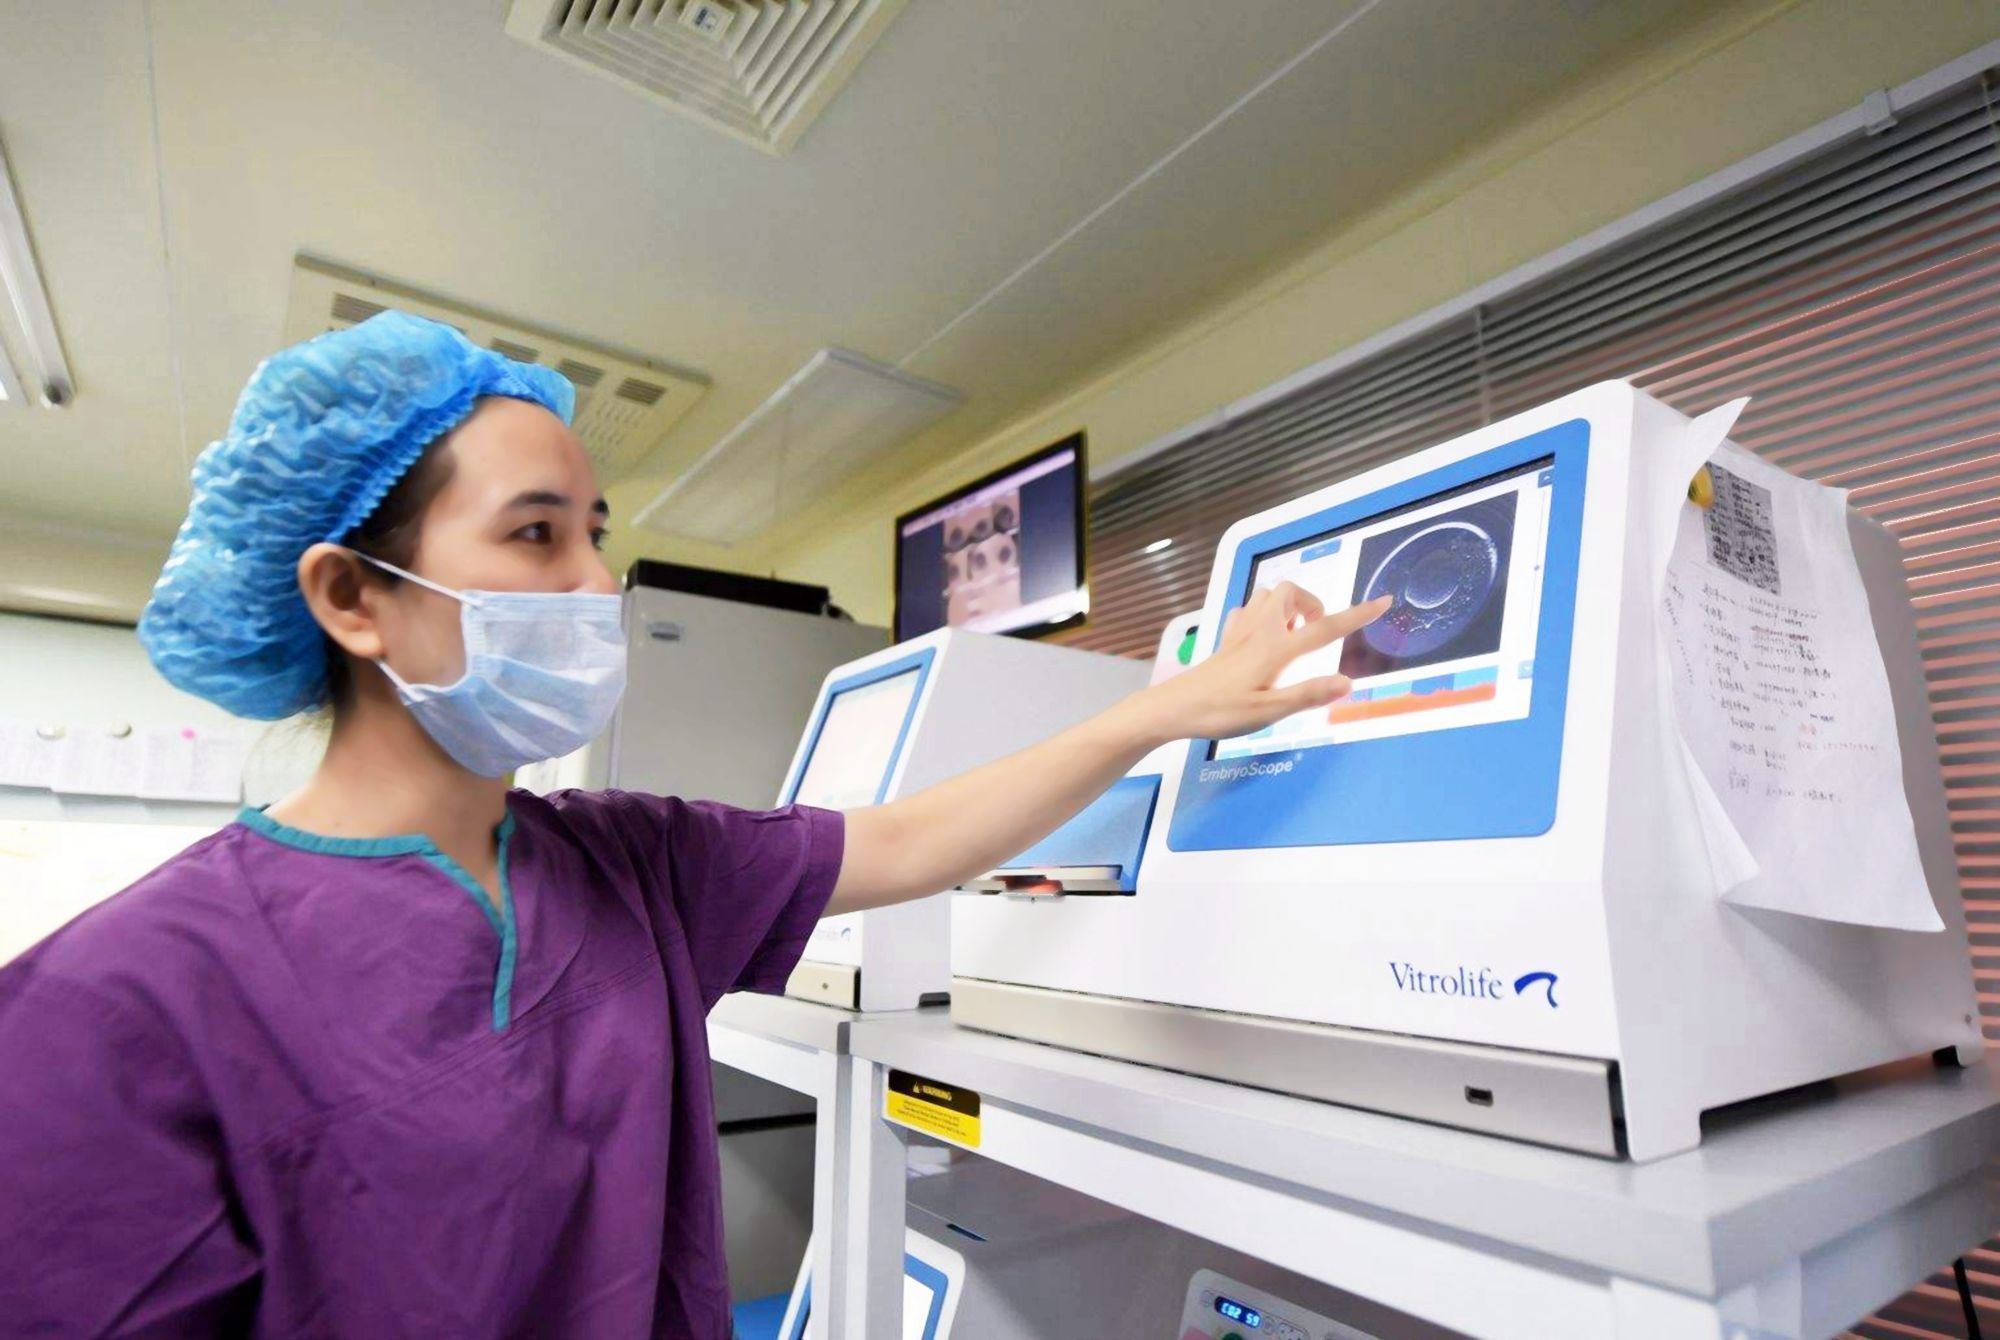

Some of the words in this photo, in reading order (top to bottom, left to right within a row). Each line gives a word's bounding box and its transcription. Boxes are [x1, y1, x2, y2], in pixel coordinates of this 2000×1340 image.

[1199, 761, 1294, 783] EmbryoScope
[1389, 961, 1503, 1000] Vitrolife
[1246, 1312, 1260, 1327] 59
